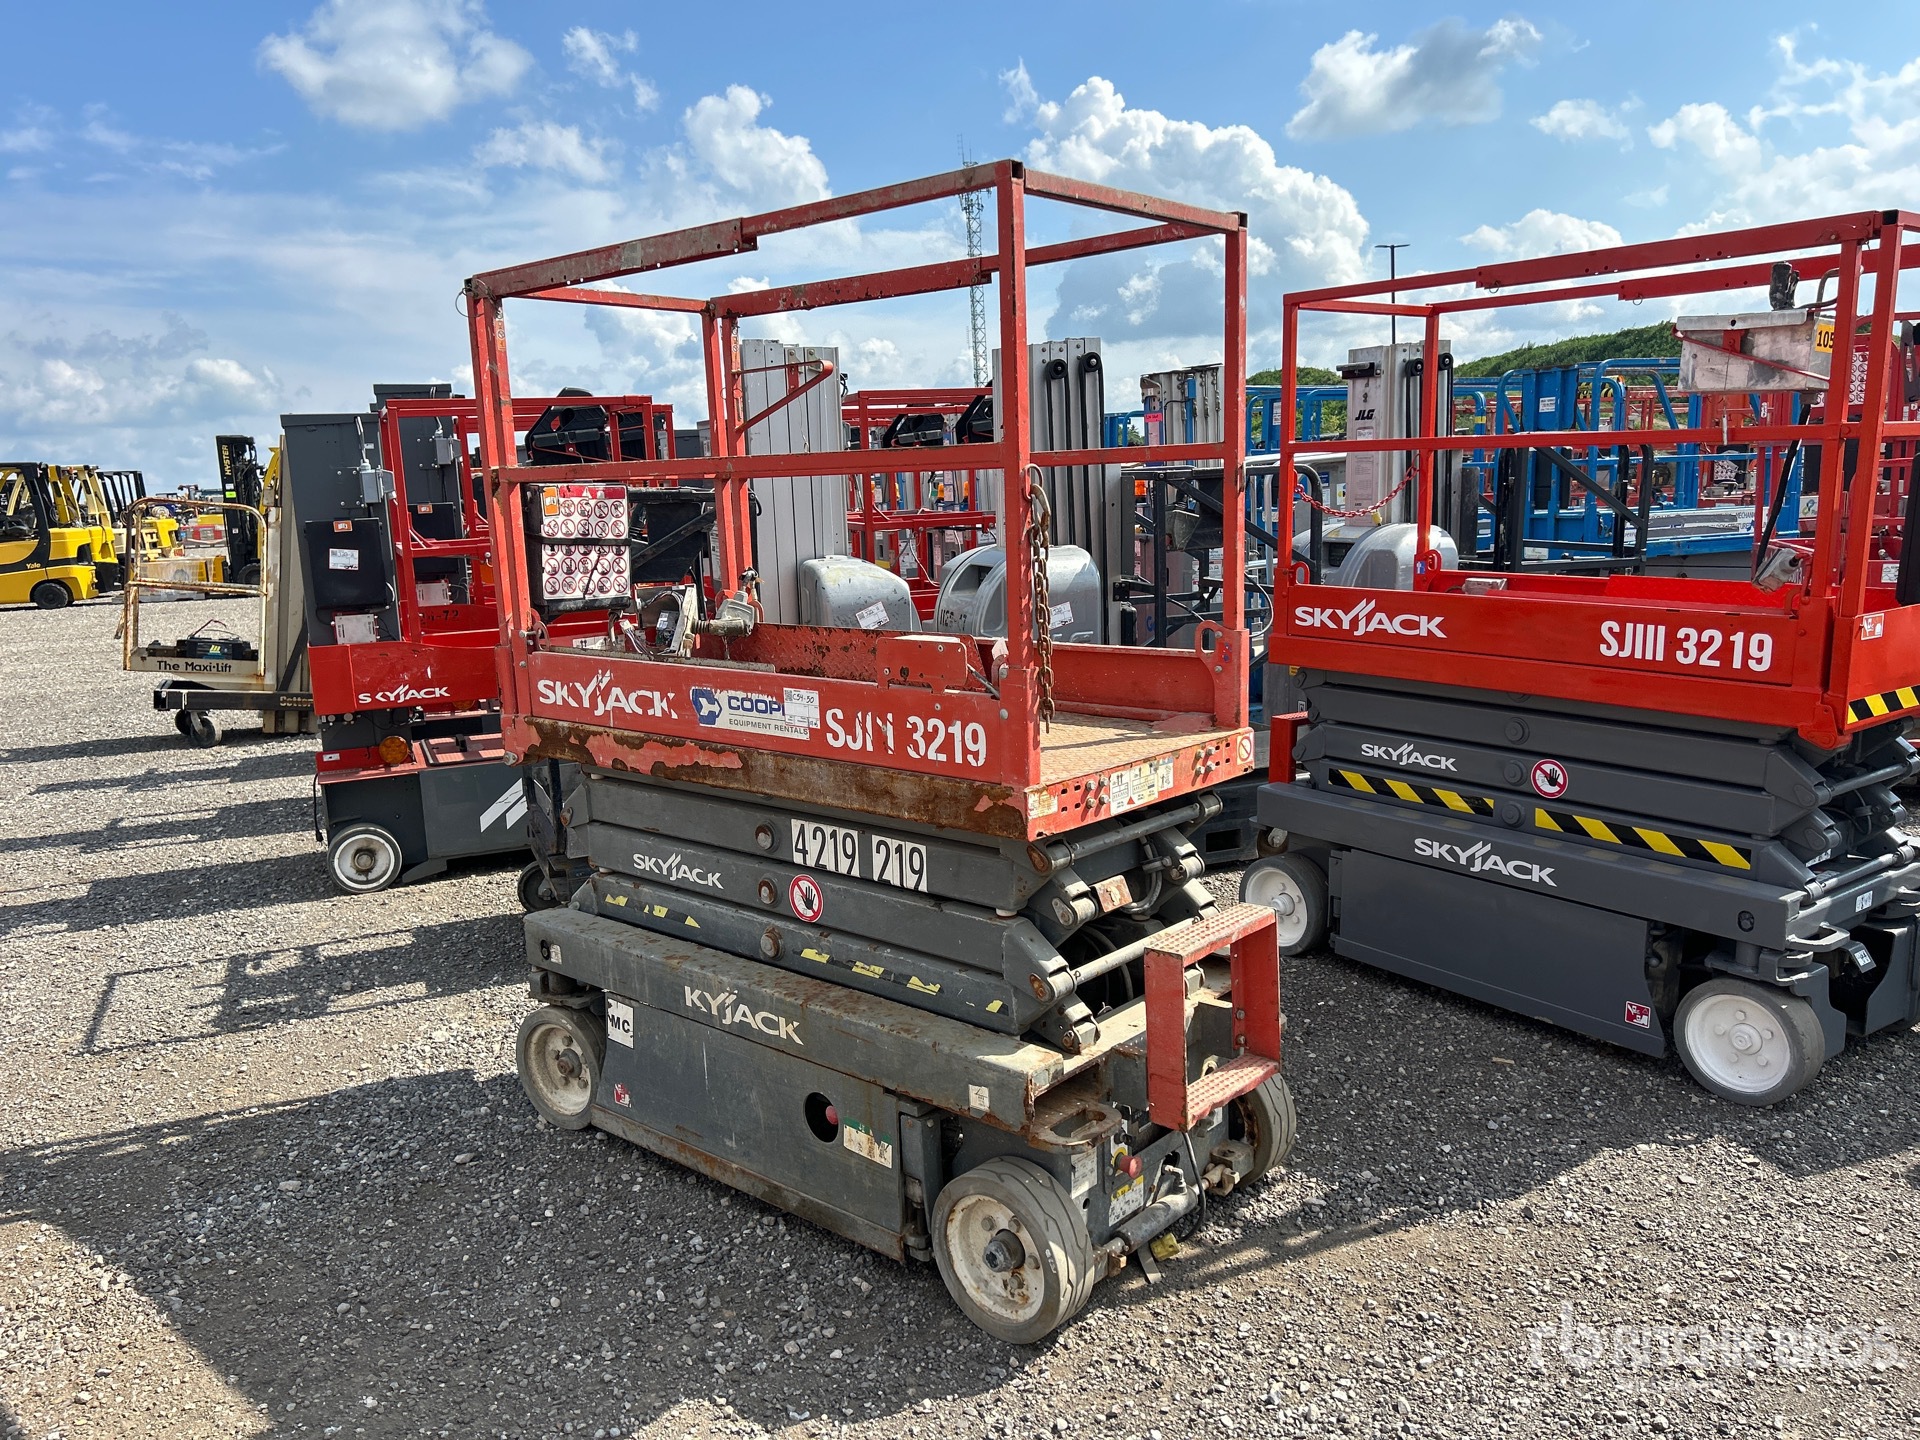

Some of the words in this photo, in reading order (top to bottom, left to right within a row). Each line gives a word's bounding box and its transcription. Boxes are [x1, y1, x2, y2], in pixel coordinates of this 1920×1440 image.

[1355, 408, 1376, 421] JLG
[221, 444, 232, 476] HYSTER
[26, 562, 41, 570] Yale
[1295, 598, 1447, 638] SKYJACK
[1599, 620, 1666, 662] SJIII
[1675, 627, 1773, 672] 3219
[157, 660, 180, 671] The
[537, 668, 679, 720] SKYJACK
[727, 694, 785, 716] COOP
[729, 718, 771, 731] EQUIPMENT
[774, 724, 809, 736] RENTALS
[906, 715, 987, 767] 3219
[1361, 742, 1458, 772] SKYJACK
[633, 852, 725, 890] SKYJACK
[794, 823, 858, 876] 4219
[874, 840, 926, 891] 219
[1414, 837, 1558, 887] SKYJACK
[607, 1013, 631, 1034] MC
